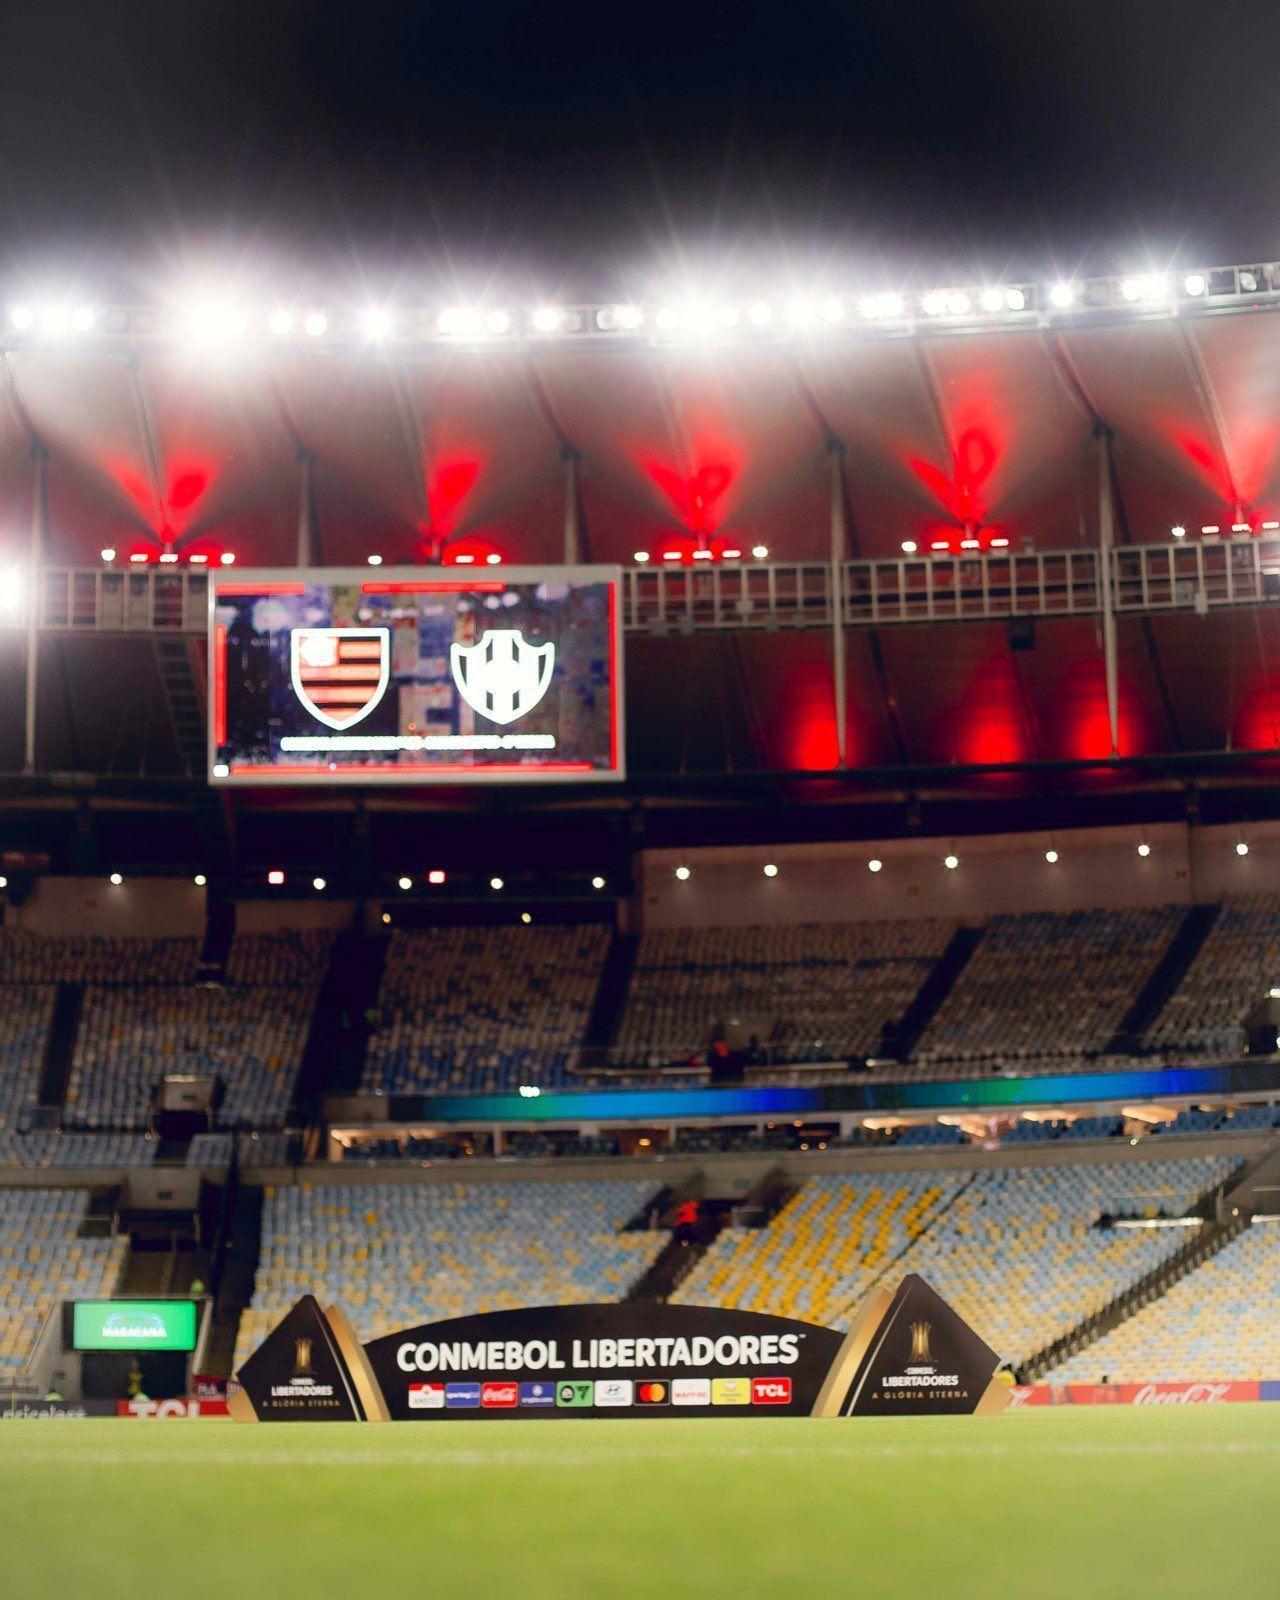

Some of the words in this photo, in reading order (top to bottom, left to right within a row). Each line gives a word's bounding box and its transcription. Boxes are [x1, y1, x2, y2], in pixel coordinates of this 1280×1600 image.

[397, 1340, 566, 1372] CONMEBOL
[573, 1334, 799, 1368] LIBERTADORES
[882, 1375, 959, 1387] LIBERTADORES
[271, 1385, 334, 1397] LIBERTADORES
[755, 1384, 788, 1397] TCL
[883, 1391, 924, 1399] GLORIA
